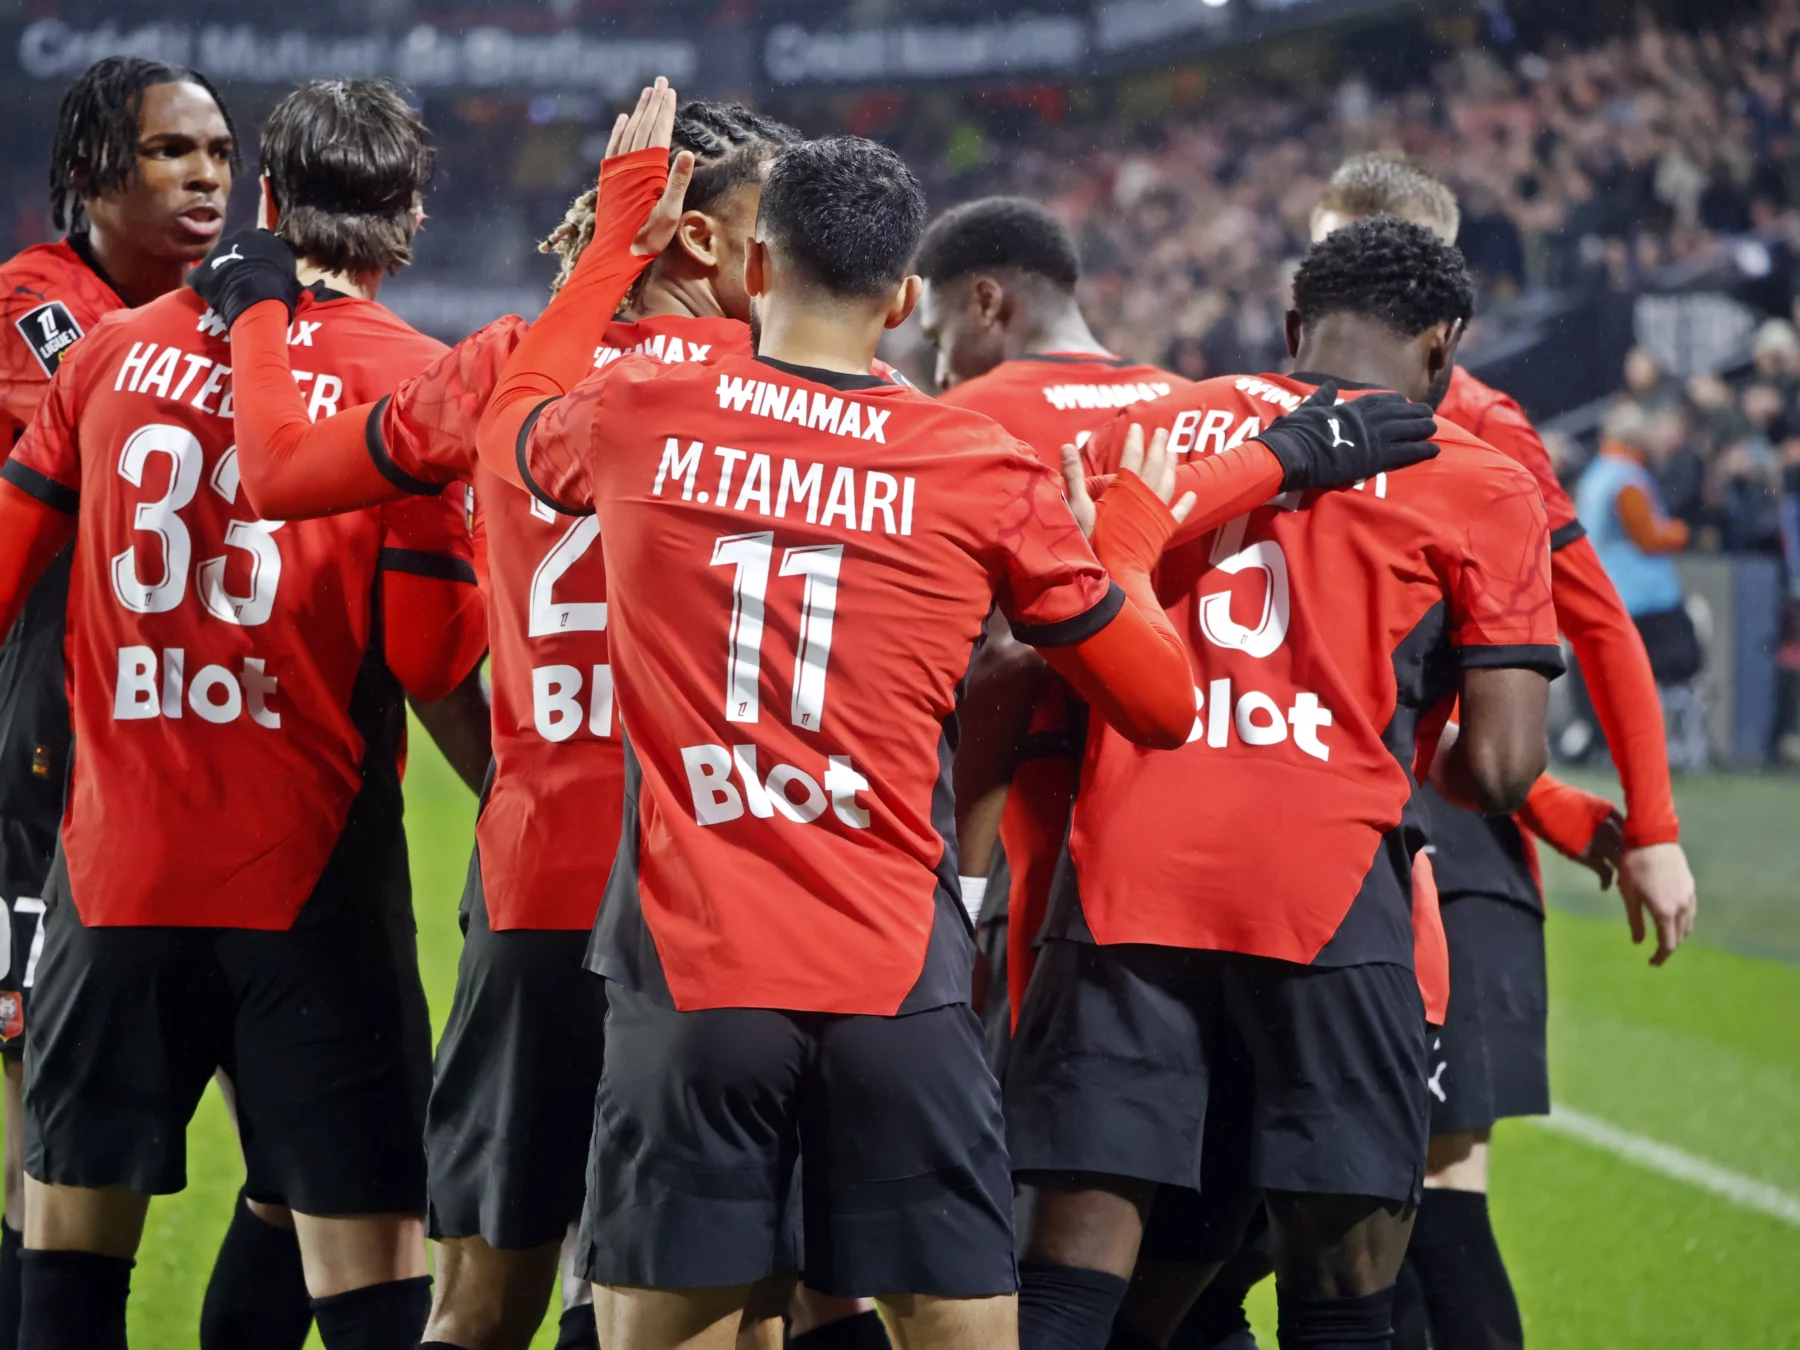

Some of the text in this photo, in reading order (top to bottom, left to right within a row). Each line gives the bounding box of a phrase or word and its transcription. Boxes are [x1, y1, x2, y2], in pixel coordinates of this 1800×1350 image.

[114, 341, 343, 424] HATER
[716, 374, 891, 444] WINAMAX
[111, 424, 286, 626] 33
[652, 438, 916, 536] M.TAMARI
[709, 531, 845, 733] 11
[113, 645, 281, 729] Blot
[532, 664, 616, 743] Bl
[681, 744, 871, 829] Blot
